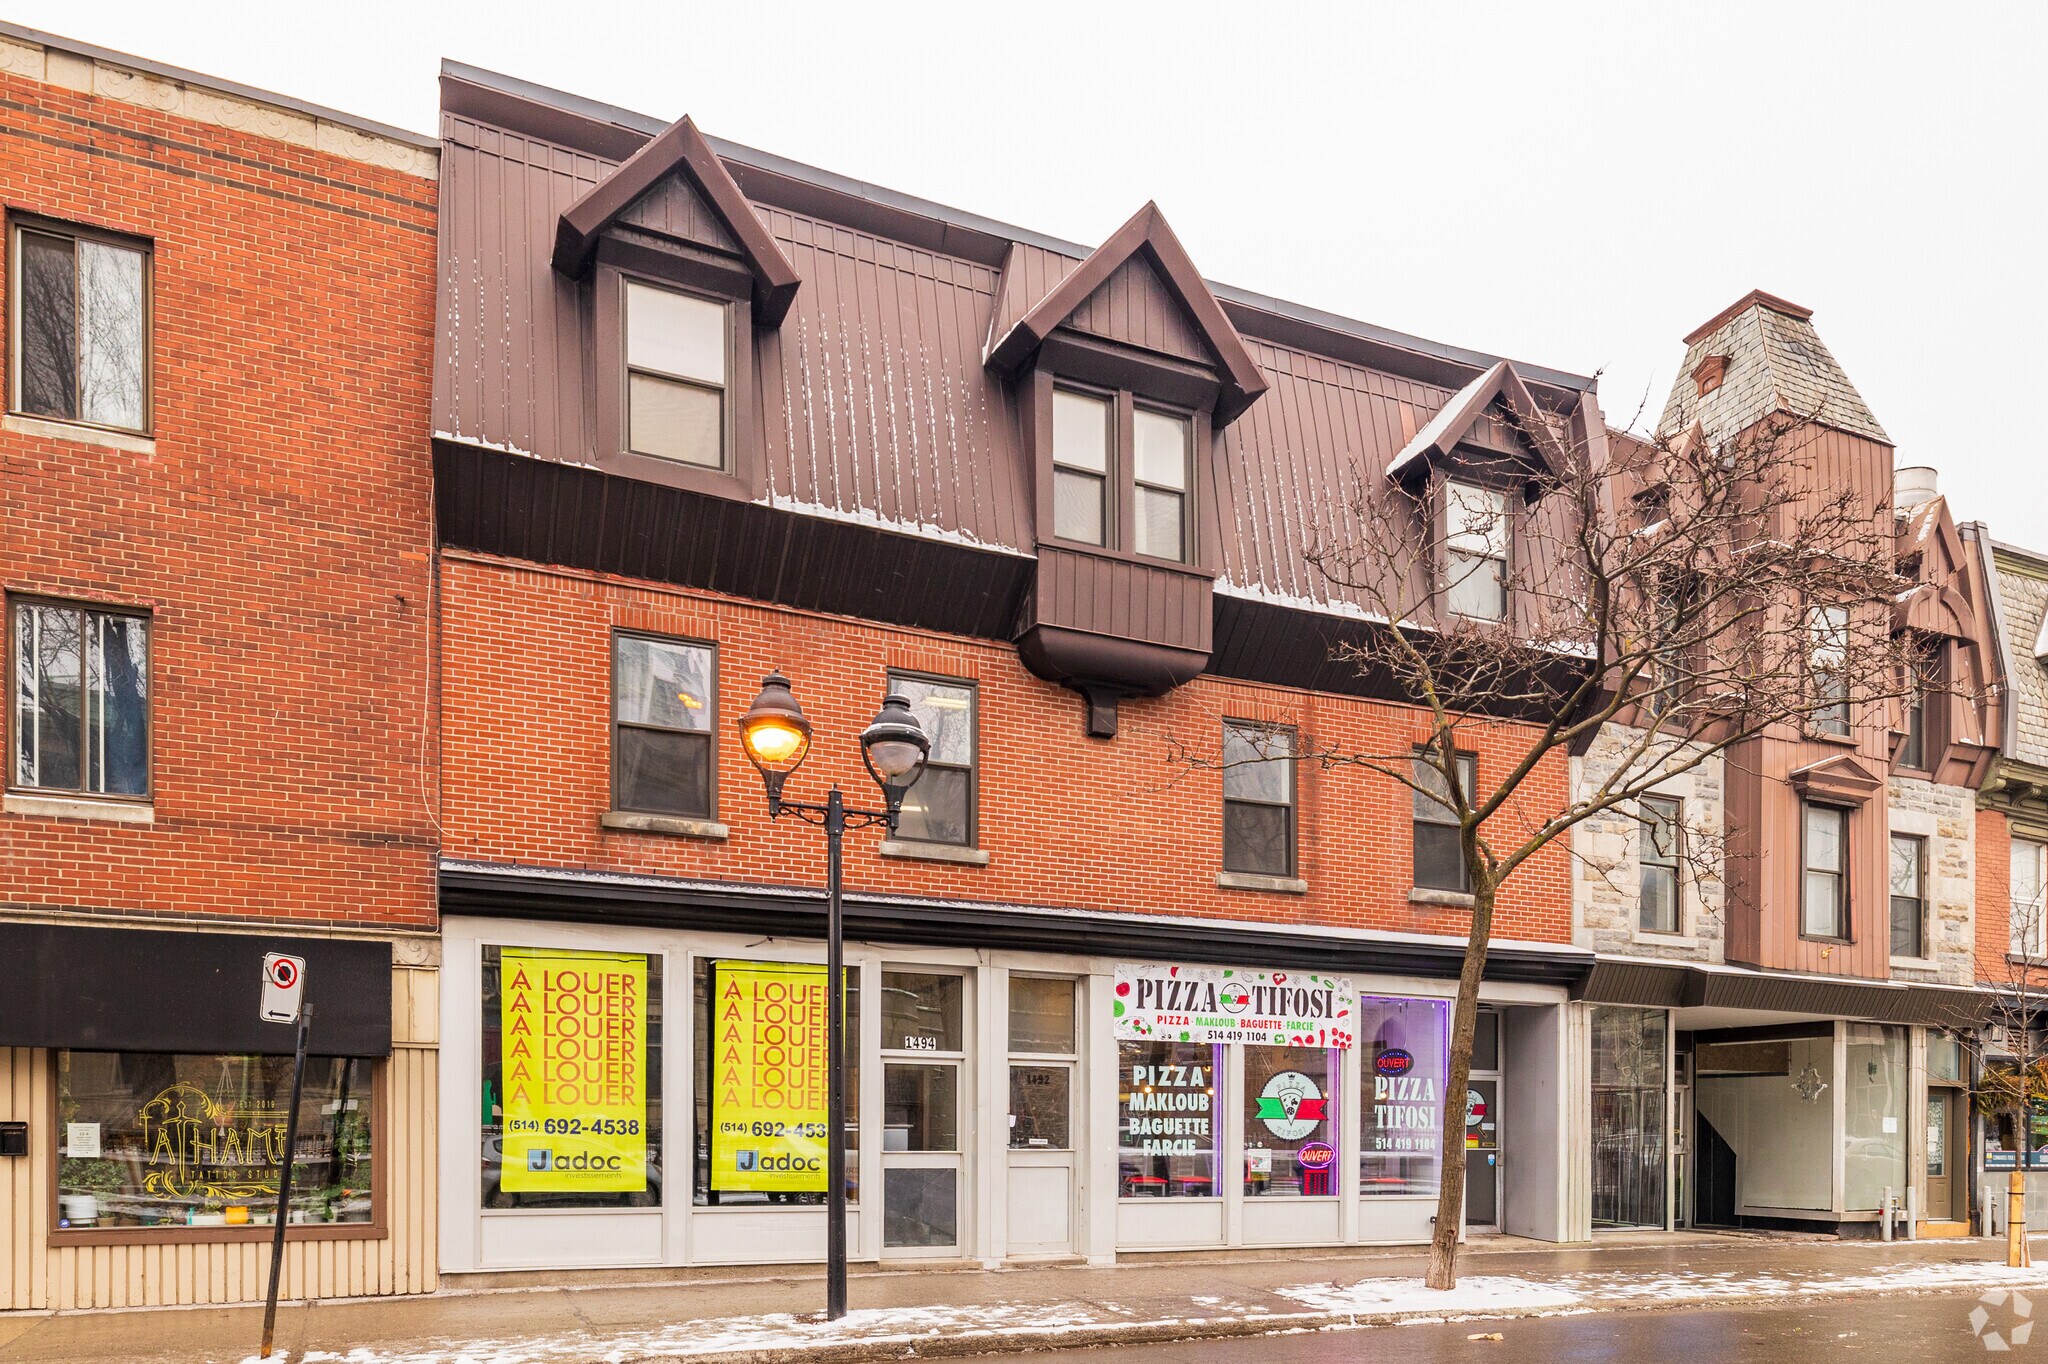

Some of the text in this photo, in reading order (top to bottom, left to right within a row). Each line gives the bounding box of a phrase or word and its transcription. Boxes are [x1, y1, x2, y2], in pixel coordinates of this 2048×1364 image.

[510, 963, 637, 995] À LOUER
[723, 974, 743, 1000] À
[510, 985, 636, 1017] À LOUER
[723, 995, 742, 1021] À
[1136, 979, 1333, 1018] PIZZA TIFOSI
[510, 1008, 636, 1039] À LOUER
[723, 1017, 742, 1043] À
[1157, 1015, 1313, 1030] PIZZA MAKLOUB BAGUETTE FARCIE
[905, 1036, 935, 1049] 1494
[1208, 1031, 1266, 1041] 514 419 1104
[510, 1031, 636, 1062] À LOUER
[722, 1039, 742, 1064] À
[510, 1054, 636, 1084] À LOUER
[1377, 1058, 1410, 1068] OUVERT
[722, 1060, 741, 1086] À
[1027, 1074, 1050, 1084] 1492
[1133, 1065, 1204, 1086] PIZZA
[510, 1077, 636, 1106] À LOUER
[721, 1082, 740, 1107] À
[1276, 1081, 1306, 1091] PIZZA
[1375, 1077, 1436, 1101] PIZZA
[256, 1100, 275, 1109] 2019
[1129, 1093, 1209, 1111] MAKLOUB
[509, 1118, 639, 1135] (514) 692-4538
[1129, 1118, 1209, 1135] BAGUETTE
[1375, 1105, 1436, 1129] TIFOSI
[720, 1121, 828, 1138] (514) 692-453
[1143, 1139, 1196, 1156] FARCIE
[1375, 1138, 1436, 1150] 514 419 1104
[532, 1151, 621, 1170] Jadoc
[740, 1152, 820, 1171] Jadoc
[1301, 1150, 1332, 1161] OUVERT
[190, 1170, 237, 1179] TATTOO
